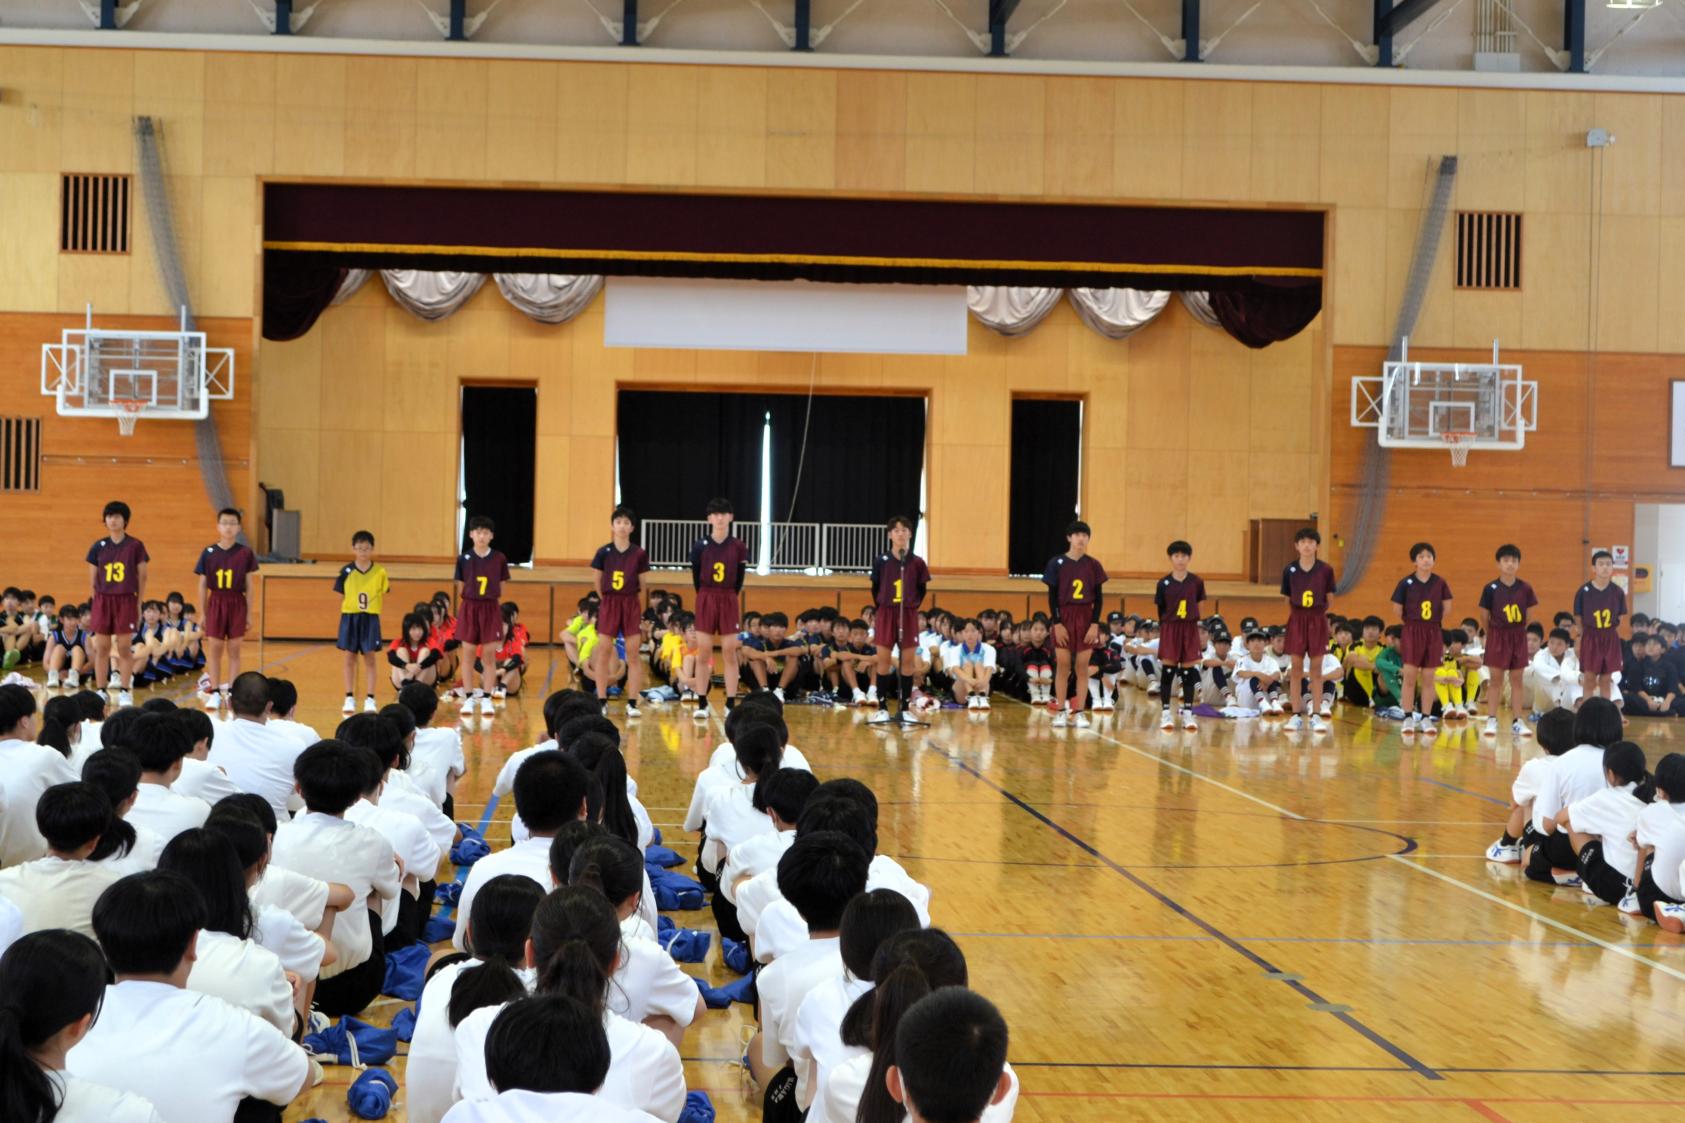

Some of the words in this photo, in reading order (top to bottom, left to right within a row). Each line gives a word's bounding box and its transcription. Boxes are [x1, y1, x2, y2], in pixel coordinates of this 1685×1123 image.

[104, 562, 126, 583] 13
[215, 569, 233, 589] 11
[611, 571, 624, 591] 5
[712, 562, 725, 583] 3
[476, 576, 487, 596] 7
[892, 578, 903, 602] 1
[1072, 579, 1084, 600] 2
[358, 592, 368, 610] 9
[1176, 599, 1188, 619] 4
[1301, 589, 1314, 608] 6
[1420, 600, 1433, 621] 8
[1503, 603, 1523, 624] 10
[1593, 608, 1612, 629] 12
